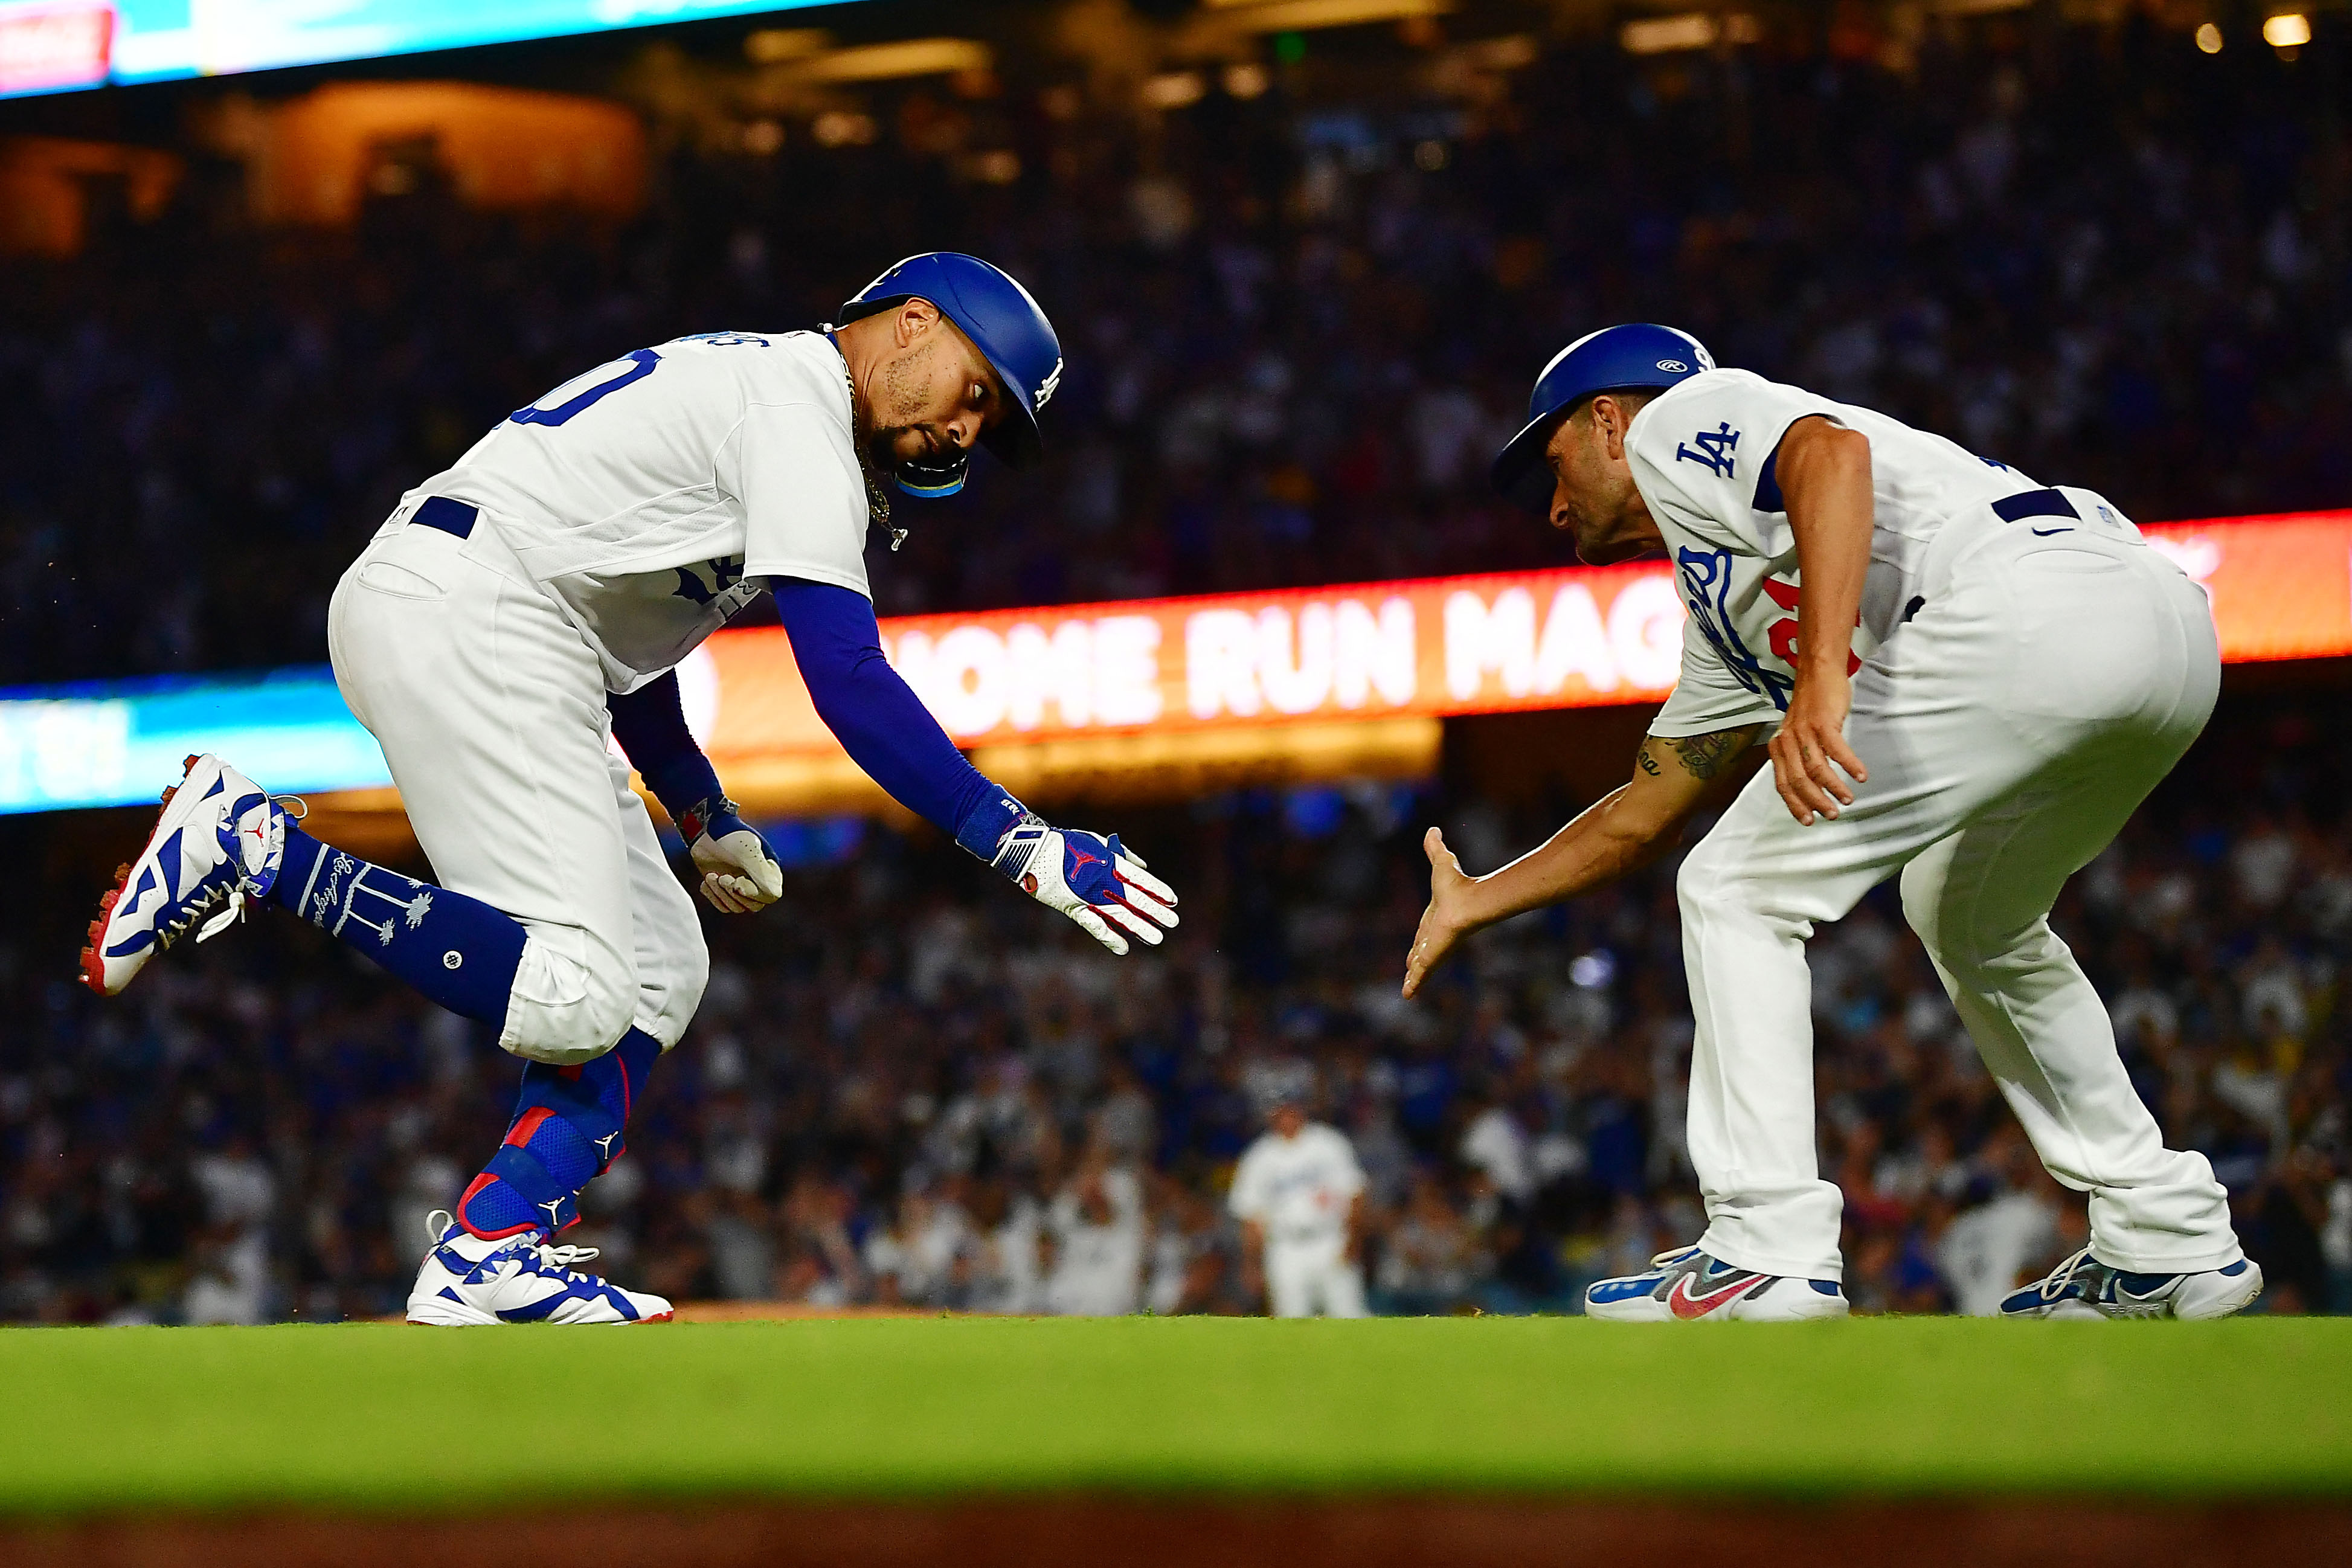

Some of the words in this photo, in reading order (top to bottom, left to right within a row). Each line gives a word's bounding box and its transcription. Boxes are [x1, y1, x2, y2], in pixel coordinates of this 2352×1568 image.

[1676, 421, 1740, 480] LA
[1186, 596, 1417, 720] RUN
[1444, 575, 1689, 702] MAG
